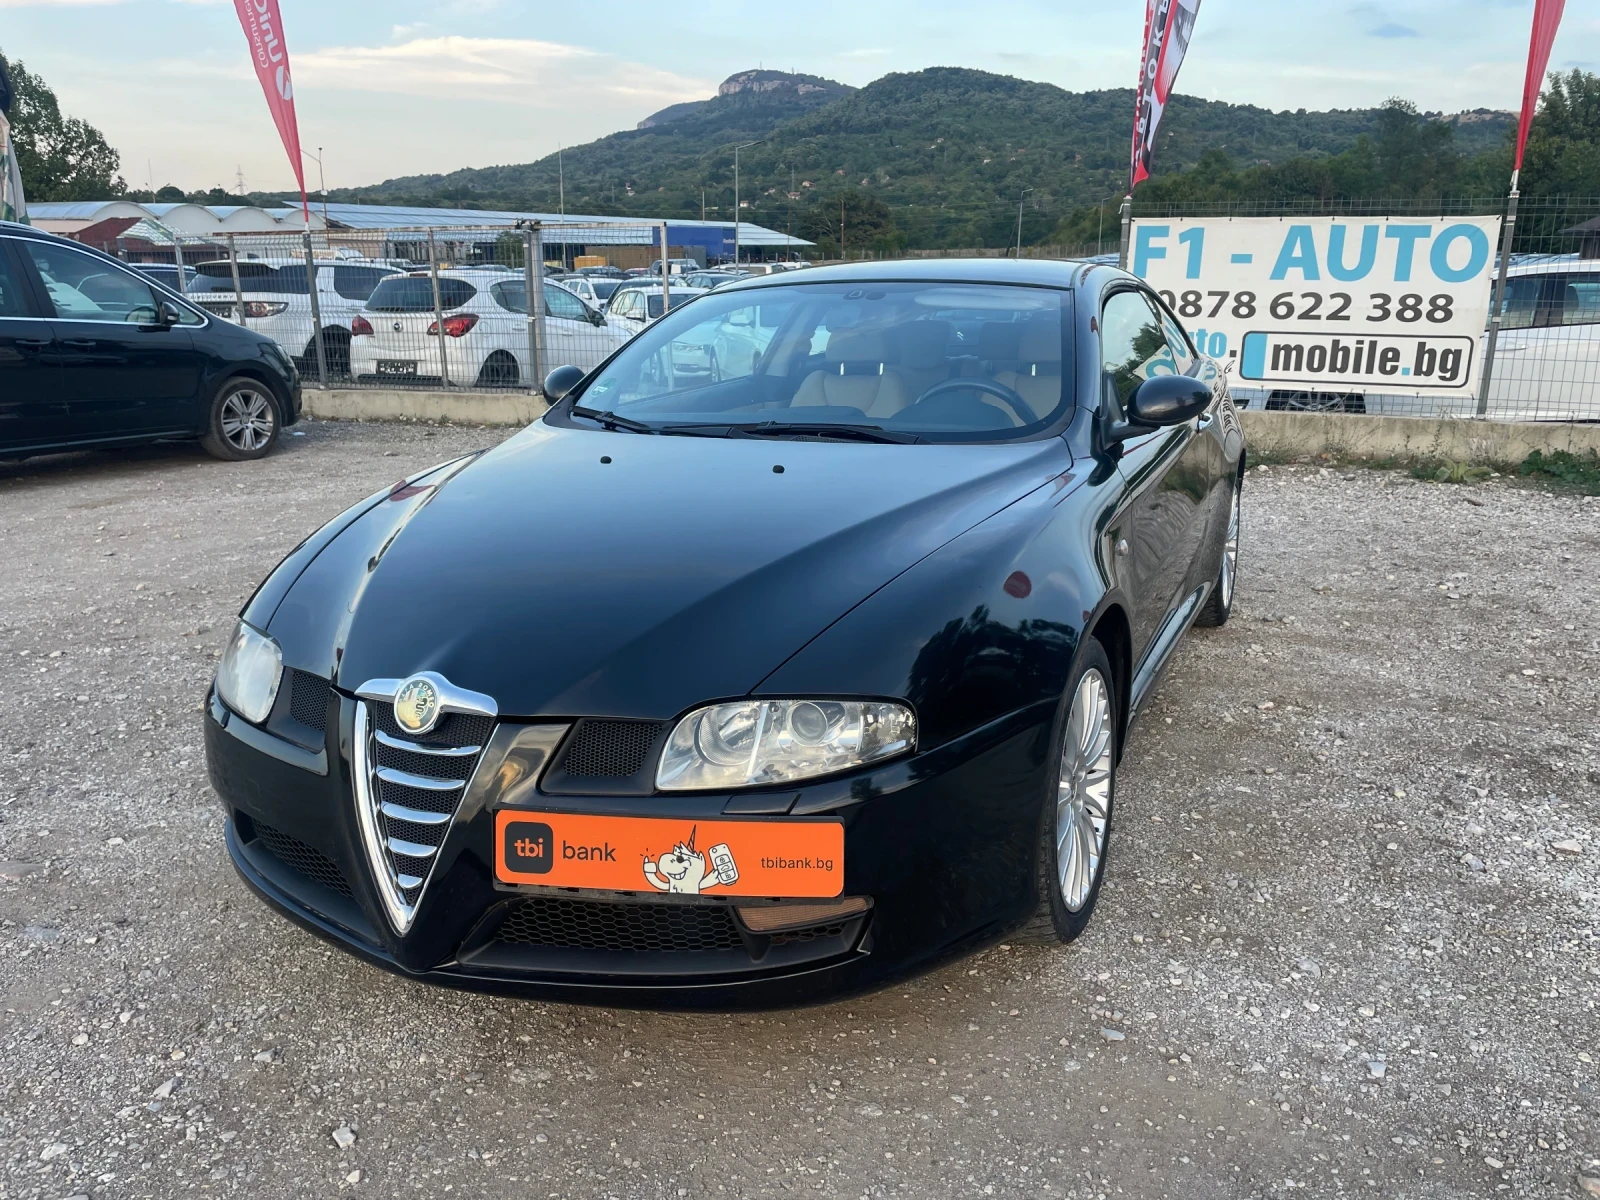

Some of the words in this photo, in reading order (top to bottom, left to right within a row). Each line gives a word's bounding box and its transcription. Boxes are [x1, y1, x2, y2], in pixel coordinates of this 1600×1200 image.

[1133, 225, 1205, 280] F1
[1230, 253, 1253, 264] -
[1269, 223, 1490, 283] AUTO
[1269, 291, 1352, 321] 622
[1365, 292, 1454, 323] 388
[1270, 339, 1463, 382] mobile.bg
[417, 683, 435, 707] ROMEO
[514, 837, 544, 859] tbi
[562, 840, 616, 862] bank
[761, 856, 834, 872] tbibank.bg
